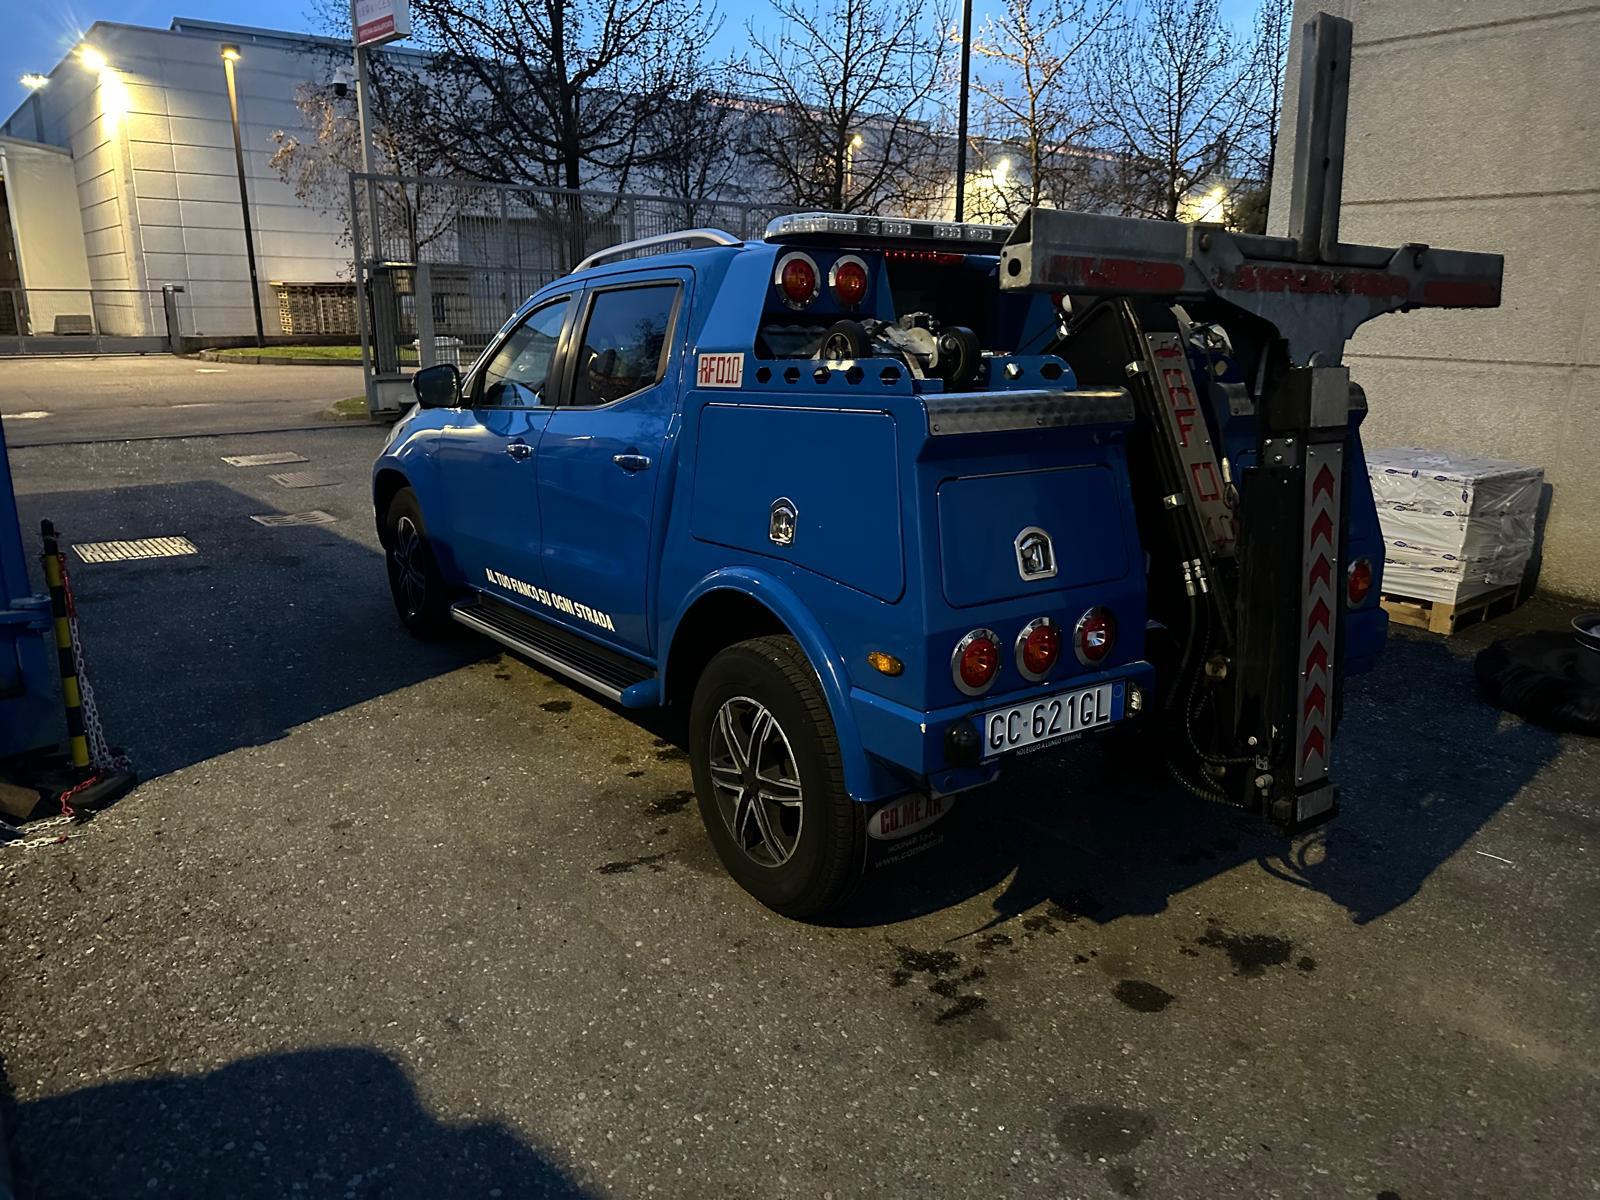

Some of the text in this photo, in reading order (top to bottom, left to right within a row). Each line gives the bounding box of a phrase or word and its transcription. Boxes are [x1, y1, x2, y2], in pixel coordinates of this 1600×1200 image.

[700, 356, 740, 384] RF010
[485, 567, 616, 632] AL TUO FIANCO SU OGNI STRADA
[1016, 743, 1041, 757] NOLEGGIO
[1045, 737, 1062, 748] LUNGO
